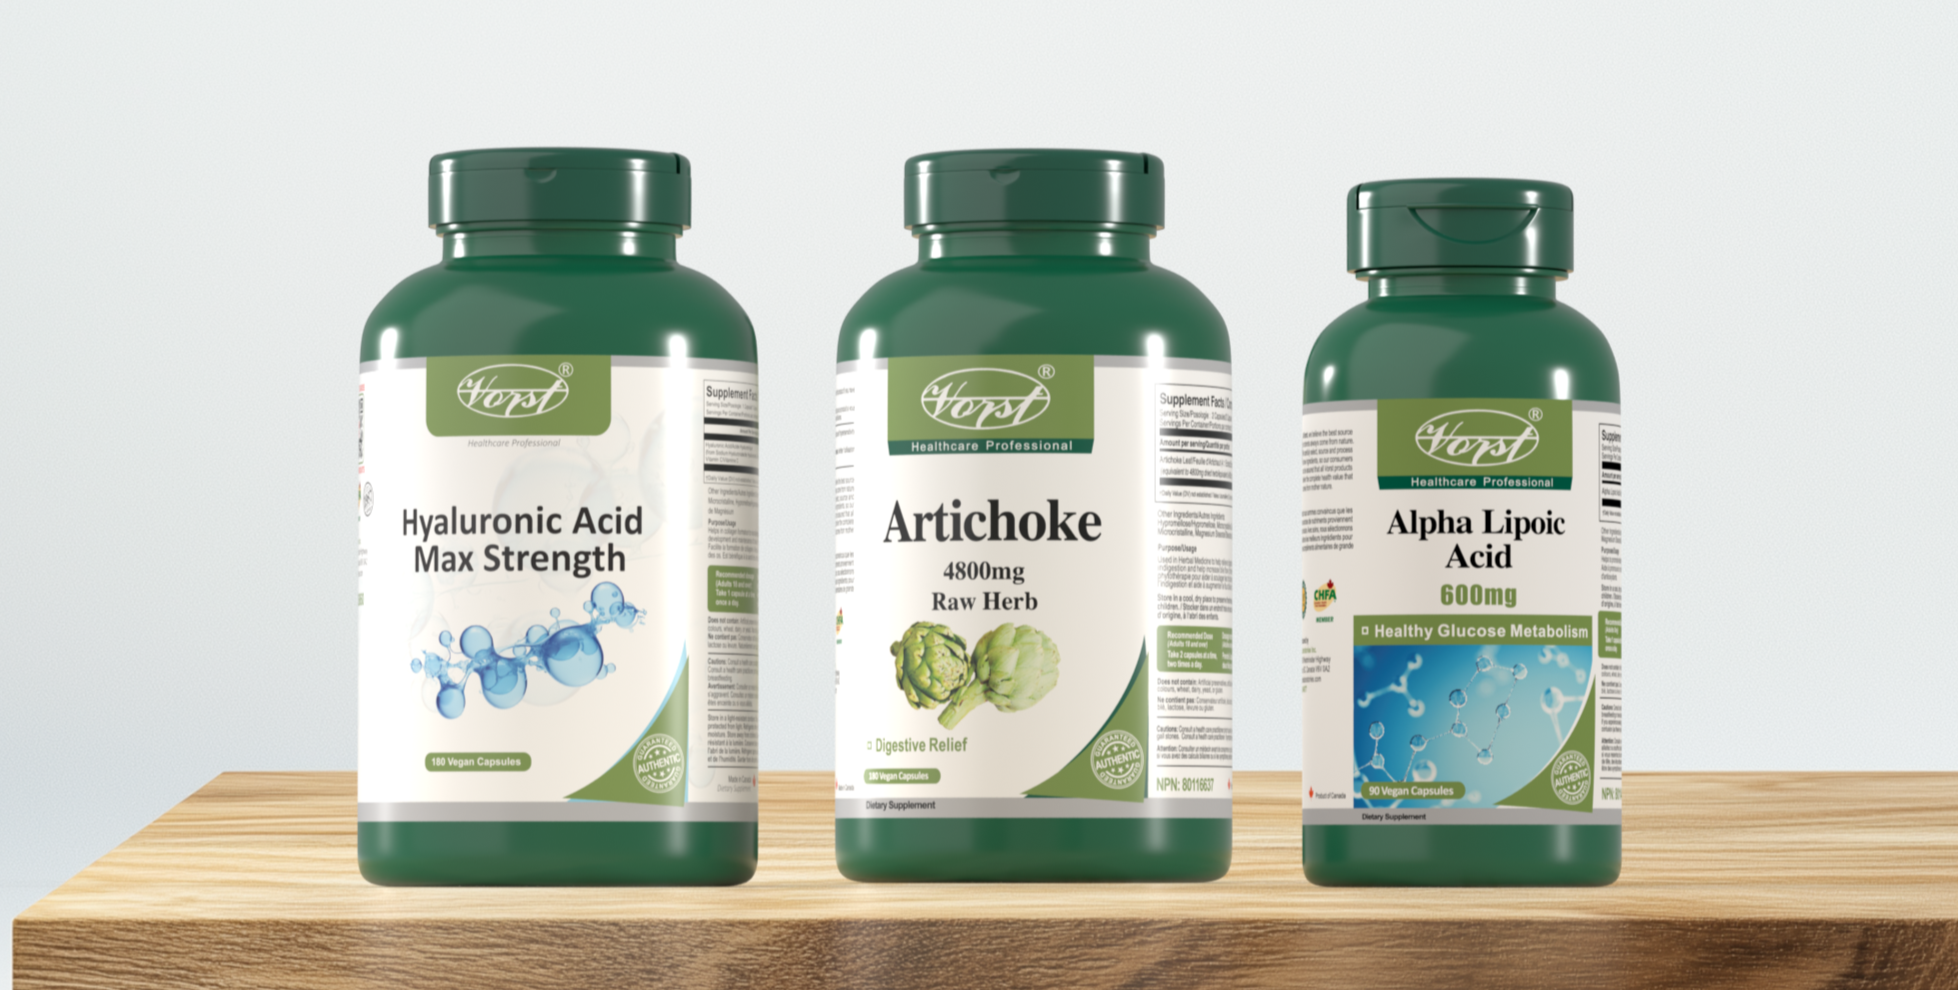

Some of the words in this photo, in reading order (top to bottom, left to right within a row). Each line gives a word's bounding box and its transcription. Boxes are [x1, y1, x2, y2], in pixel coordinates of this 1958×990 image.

[459, 373, 568, 418] Vorst
[706, 385, 748, 400] Supplement
[1159, 392, 1209, 408] Supplement
[923, 381, 1049, 430] Vorst
[467, 438, 509, 448] Healthcare
[511, 437, 560, 448] Professional
[911, 441, 978, 452] Healthcare
[986, 440, 1072, 452] Professional
[1417, 421, 1538, 466] Vorst
[1410, 477, 1477, 488] Healthcare
[1483, 477, 1554, 488] Professional
[402, 505, 562, 542] Hyaluronic
[572, 505, 643, 535] Acid
[883, 499, 1102, 543] Artichoke
[1387, 509, 1473, 541] Alpha
[1482, 509, 1566, 541] Lipoic
[414, 544, 474, 573] Max
[483, 543, 626, 579] Strength
[1445, 543, 1513, 569] Acid
[943, 561, 1025, 584] 4800mg
[931, 592, 977, 611] Raw
[982, 591, 1039, 611] Herb
[1314, 589, 1337, 601] CHFA
[1440, 583, 1517, 608] 600mg
[1374, 623, 1433, 641] Healthy
[1437, 623, 1506, 638] Glucose
[1510, 623, 1589, 639] Metabolism
[875, 737, 926, 756] Digestive
[930, 737, 968, 752] Relief
[431, 757, 446, 767] 180
[447, 757, 475, 769] Vegan
[476, 756, 522, 769] Capsules
[638, 753, 681, 774] AUTHENTIC
[1095, 749, 1140, 770] AUTHENTIC
[879, 772, 898, 782] Vegan
[898, 771, 929, 782] Capsules
[1156, 777, 1180, 792] NPN:
[1182, 777, 1214, 792] 80116637
[1555, 768, 1589, 789] AUTHENTIC
[1331, 792, 1346, 800] Canada
[1368, 786, 1380, 796] 90
[1381, 786, 1409, 798] Vegan
[1411, 785, 1454, 798] Capsules
[866, 800, 888, 811] Dietary
[889, 800, 936, 812] Supplement
[1362, 813, 1384, 822] Dietary
[1385, 813, 1427, 822] Supplement
